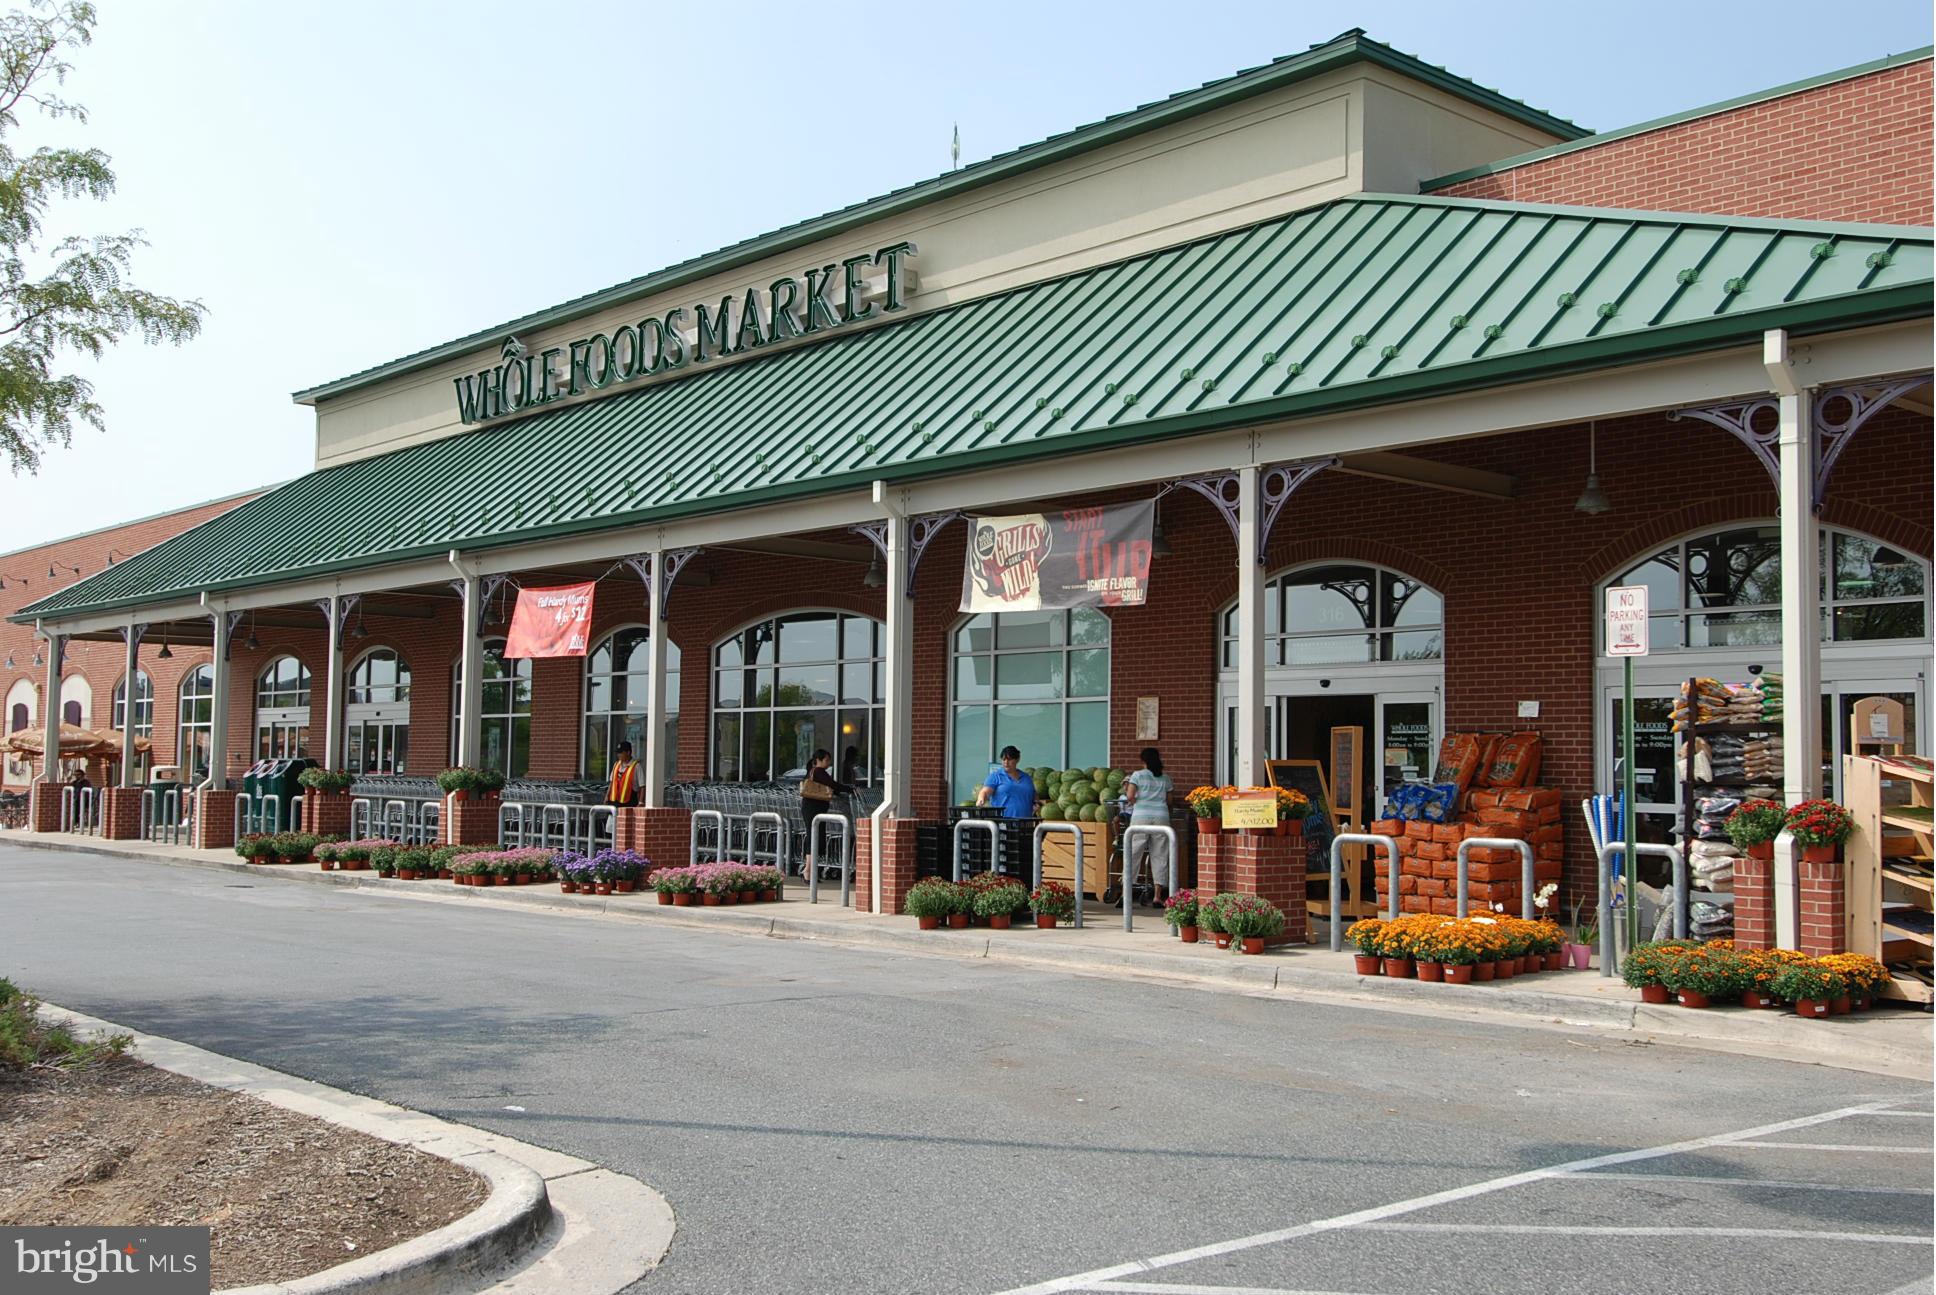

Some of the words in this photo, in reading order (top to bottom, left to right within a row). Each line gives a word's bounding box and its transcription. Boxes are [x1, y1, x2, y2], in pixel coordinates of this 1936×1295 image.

[453, 343, 567, 425] WHOLE
[568, 306, 691, 395] FOODS
[693, 241, 919, 363] MARKET
[1062, 506, 1105, 533] START
[995, 525, 1041, 567] GRILLS
[1075, 529, 1105, 580] IT
[1087, 578, 1109, 592] IGNITE
[1109, 576, 1138, 590] FLAVOR
[538, 596, 549, 607] Fall
[548, 596, 568, 609] Hardy
[567, 594, 590, 604] Mums
[1121, 589, 1144, 602] GRILL!
[1620, 593, 1634, 606] NO
[555, 608, 563, 623] 4
[1610, 609, 1644, 622] PARKING
[1620, 623, 1634, 632] ANY
[1620, 633, 1635, 643] TIME
